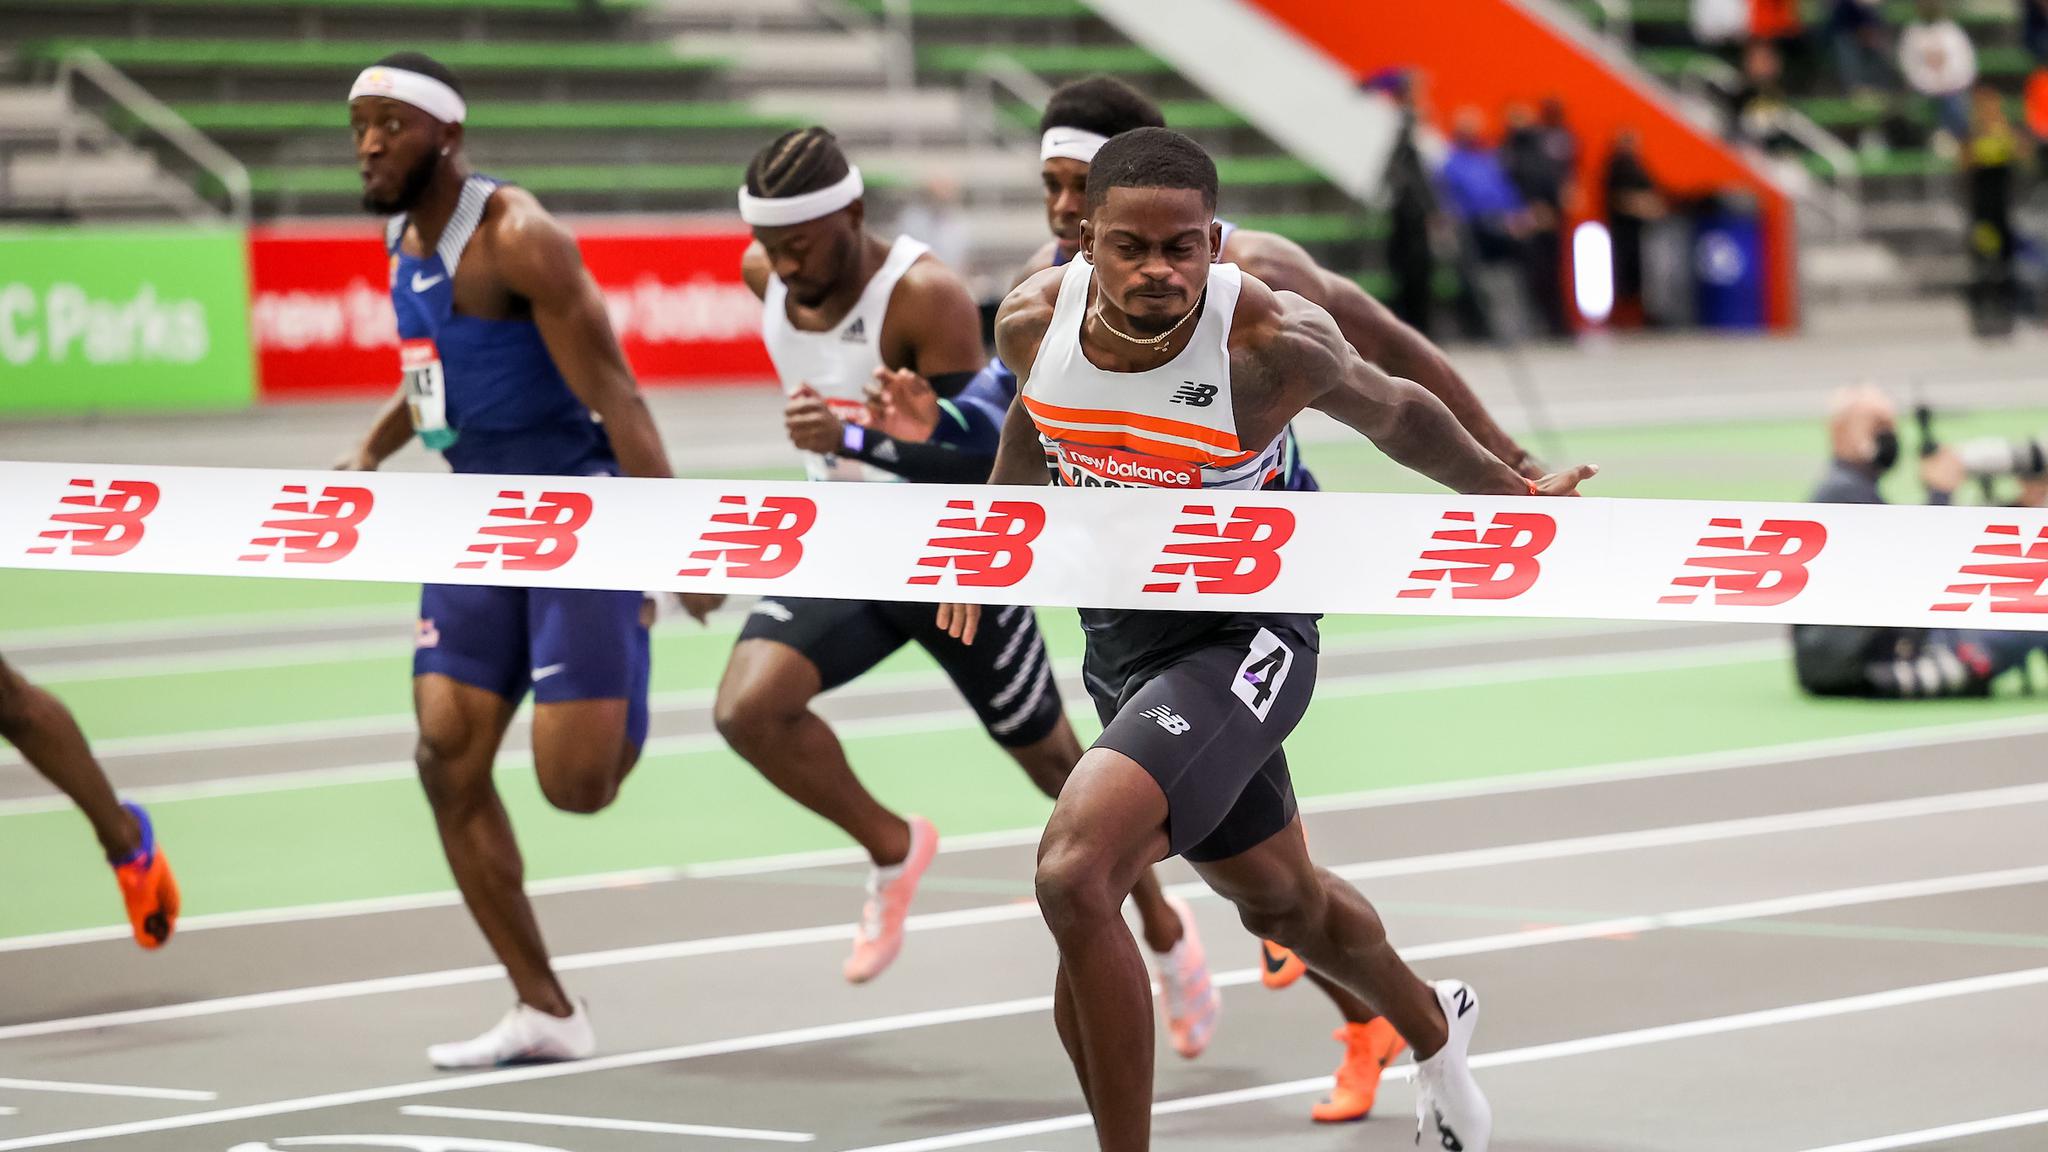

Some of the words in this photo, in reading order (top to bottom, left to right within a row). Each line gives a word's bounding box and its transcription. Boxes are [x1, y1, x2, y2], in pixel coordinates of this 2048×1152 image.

[47, 280, 209, 364] Parks
[1070, 450, 1105, 471] new
[1106, 455, 1191, 486] balance
[28, 479, 160, 556] NB
[240, 485, 374, 563] NB
[457, 490, 593, 571] NB
[678, 496, 817, 579] NB
[907, 500, 1046, 587] NB
[1143, 505, 1296, 594] NB
[1397, 512, 1557, 600] NB
[1660, 518, 1827, 606] NB
[1243, 646, 1287, 710] 4
